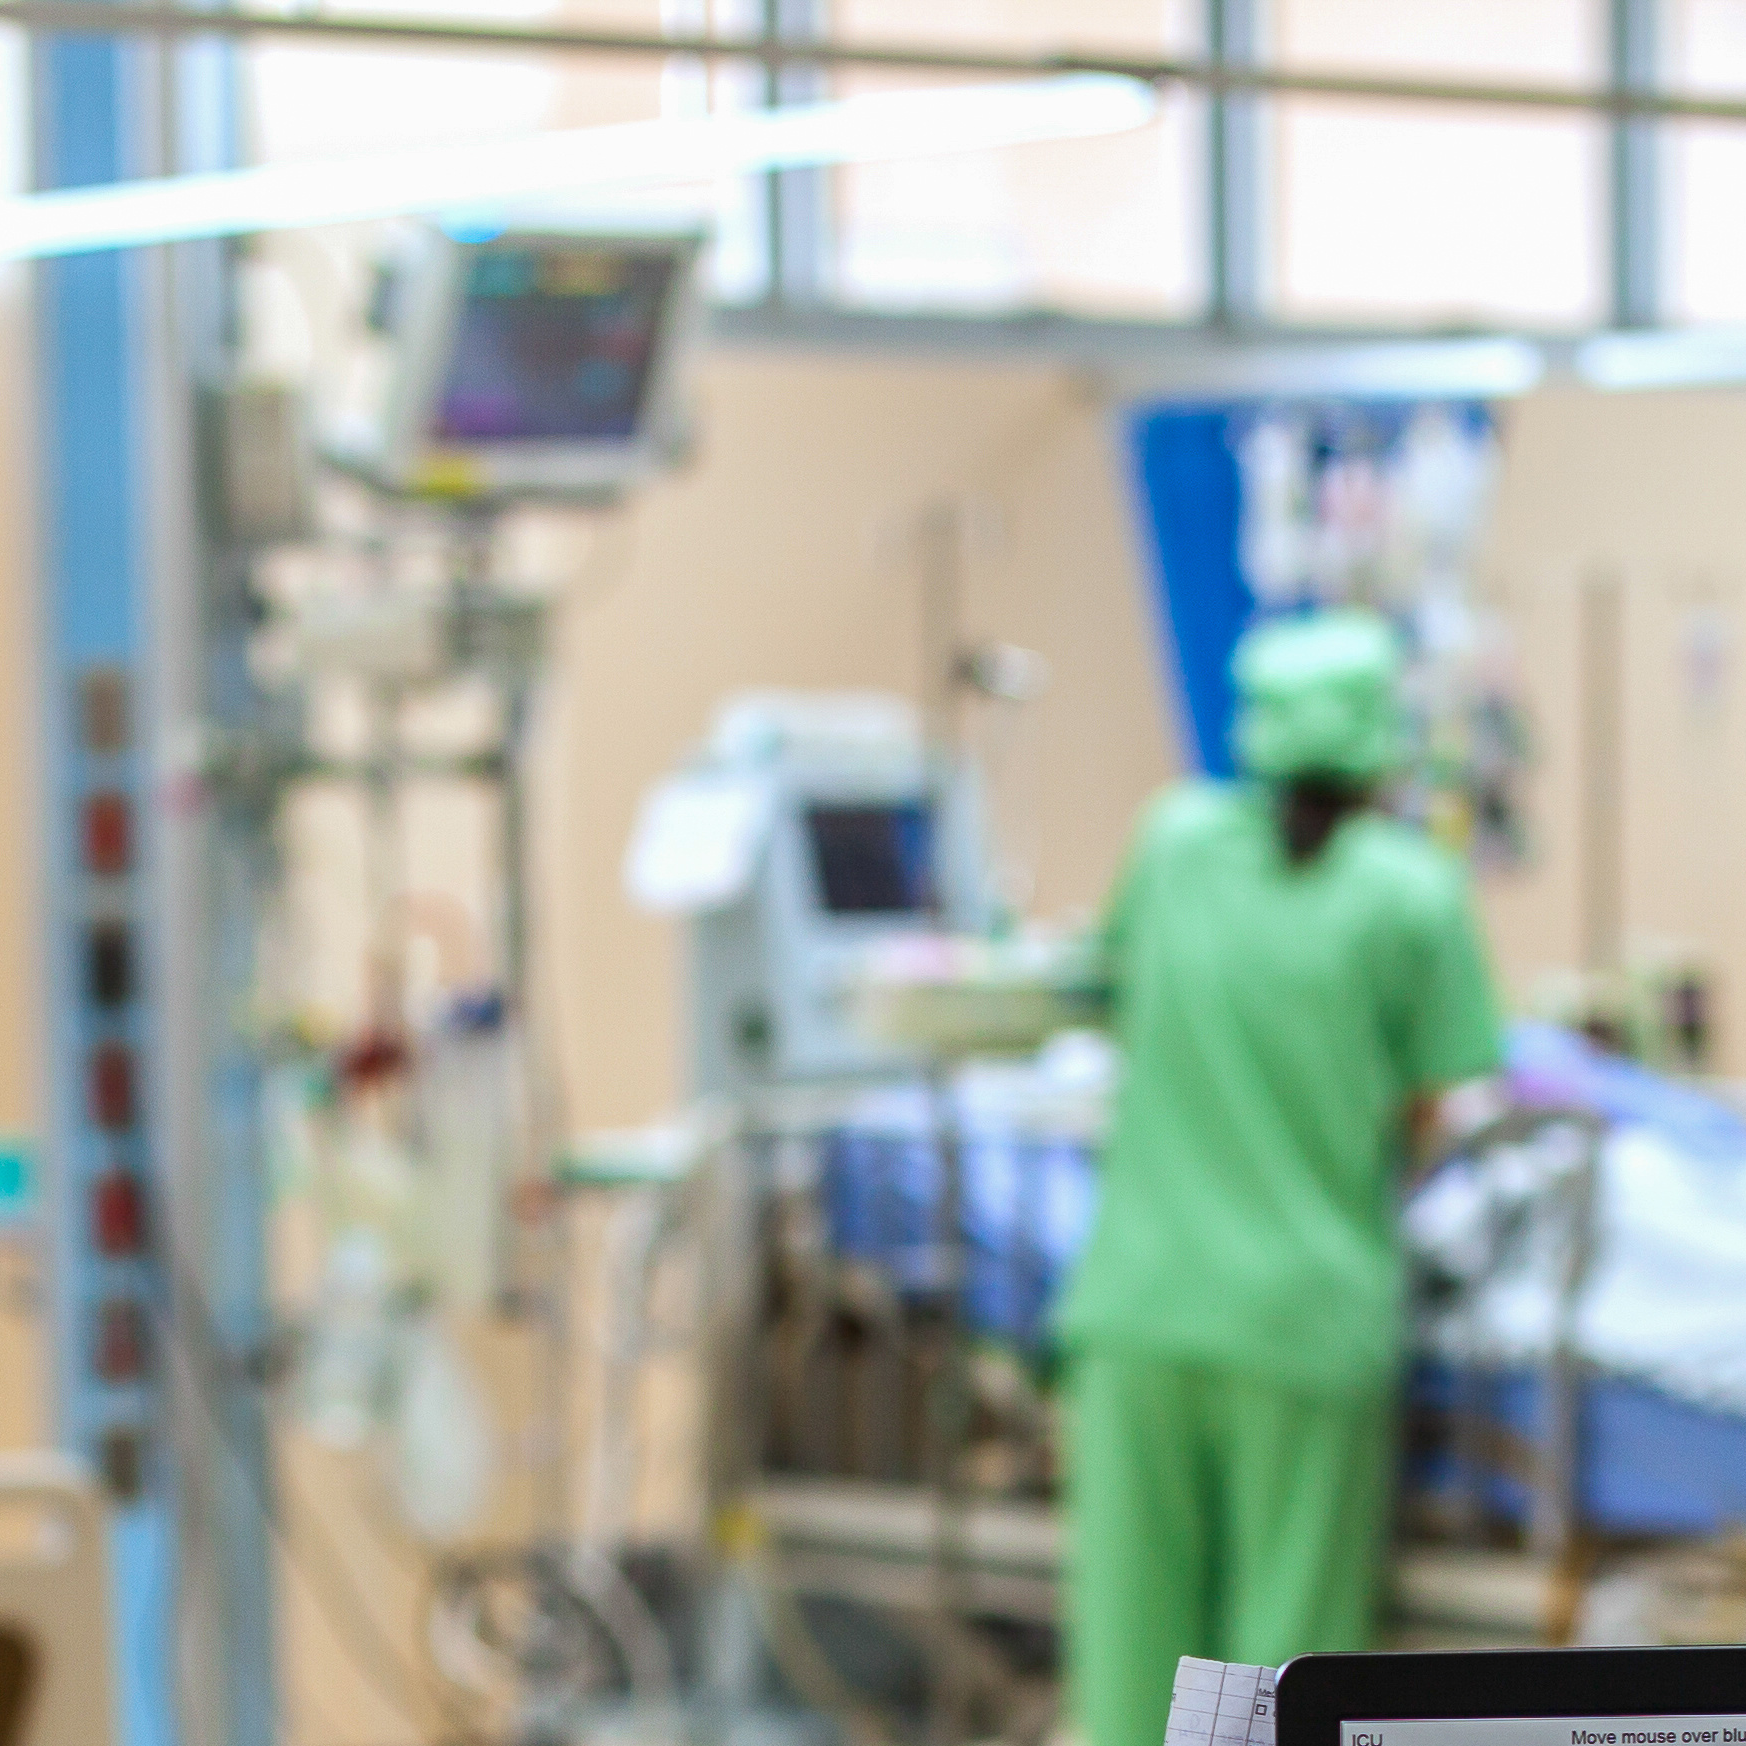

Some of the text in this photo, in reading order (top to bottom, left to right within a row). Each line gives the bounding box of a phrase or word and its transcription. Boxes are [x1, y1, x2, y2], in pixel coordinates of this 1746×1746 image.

[1572, 1731, 1616, 1744] Move
[1622, 1731, 1676, 1743] mouse
[1682, 1731, 1718, 1743] over
